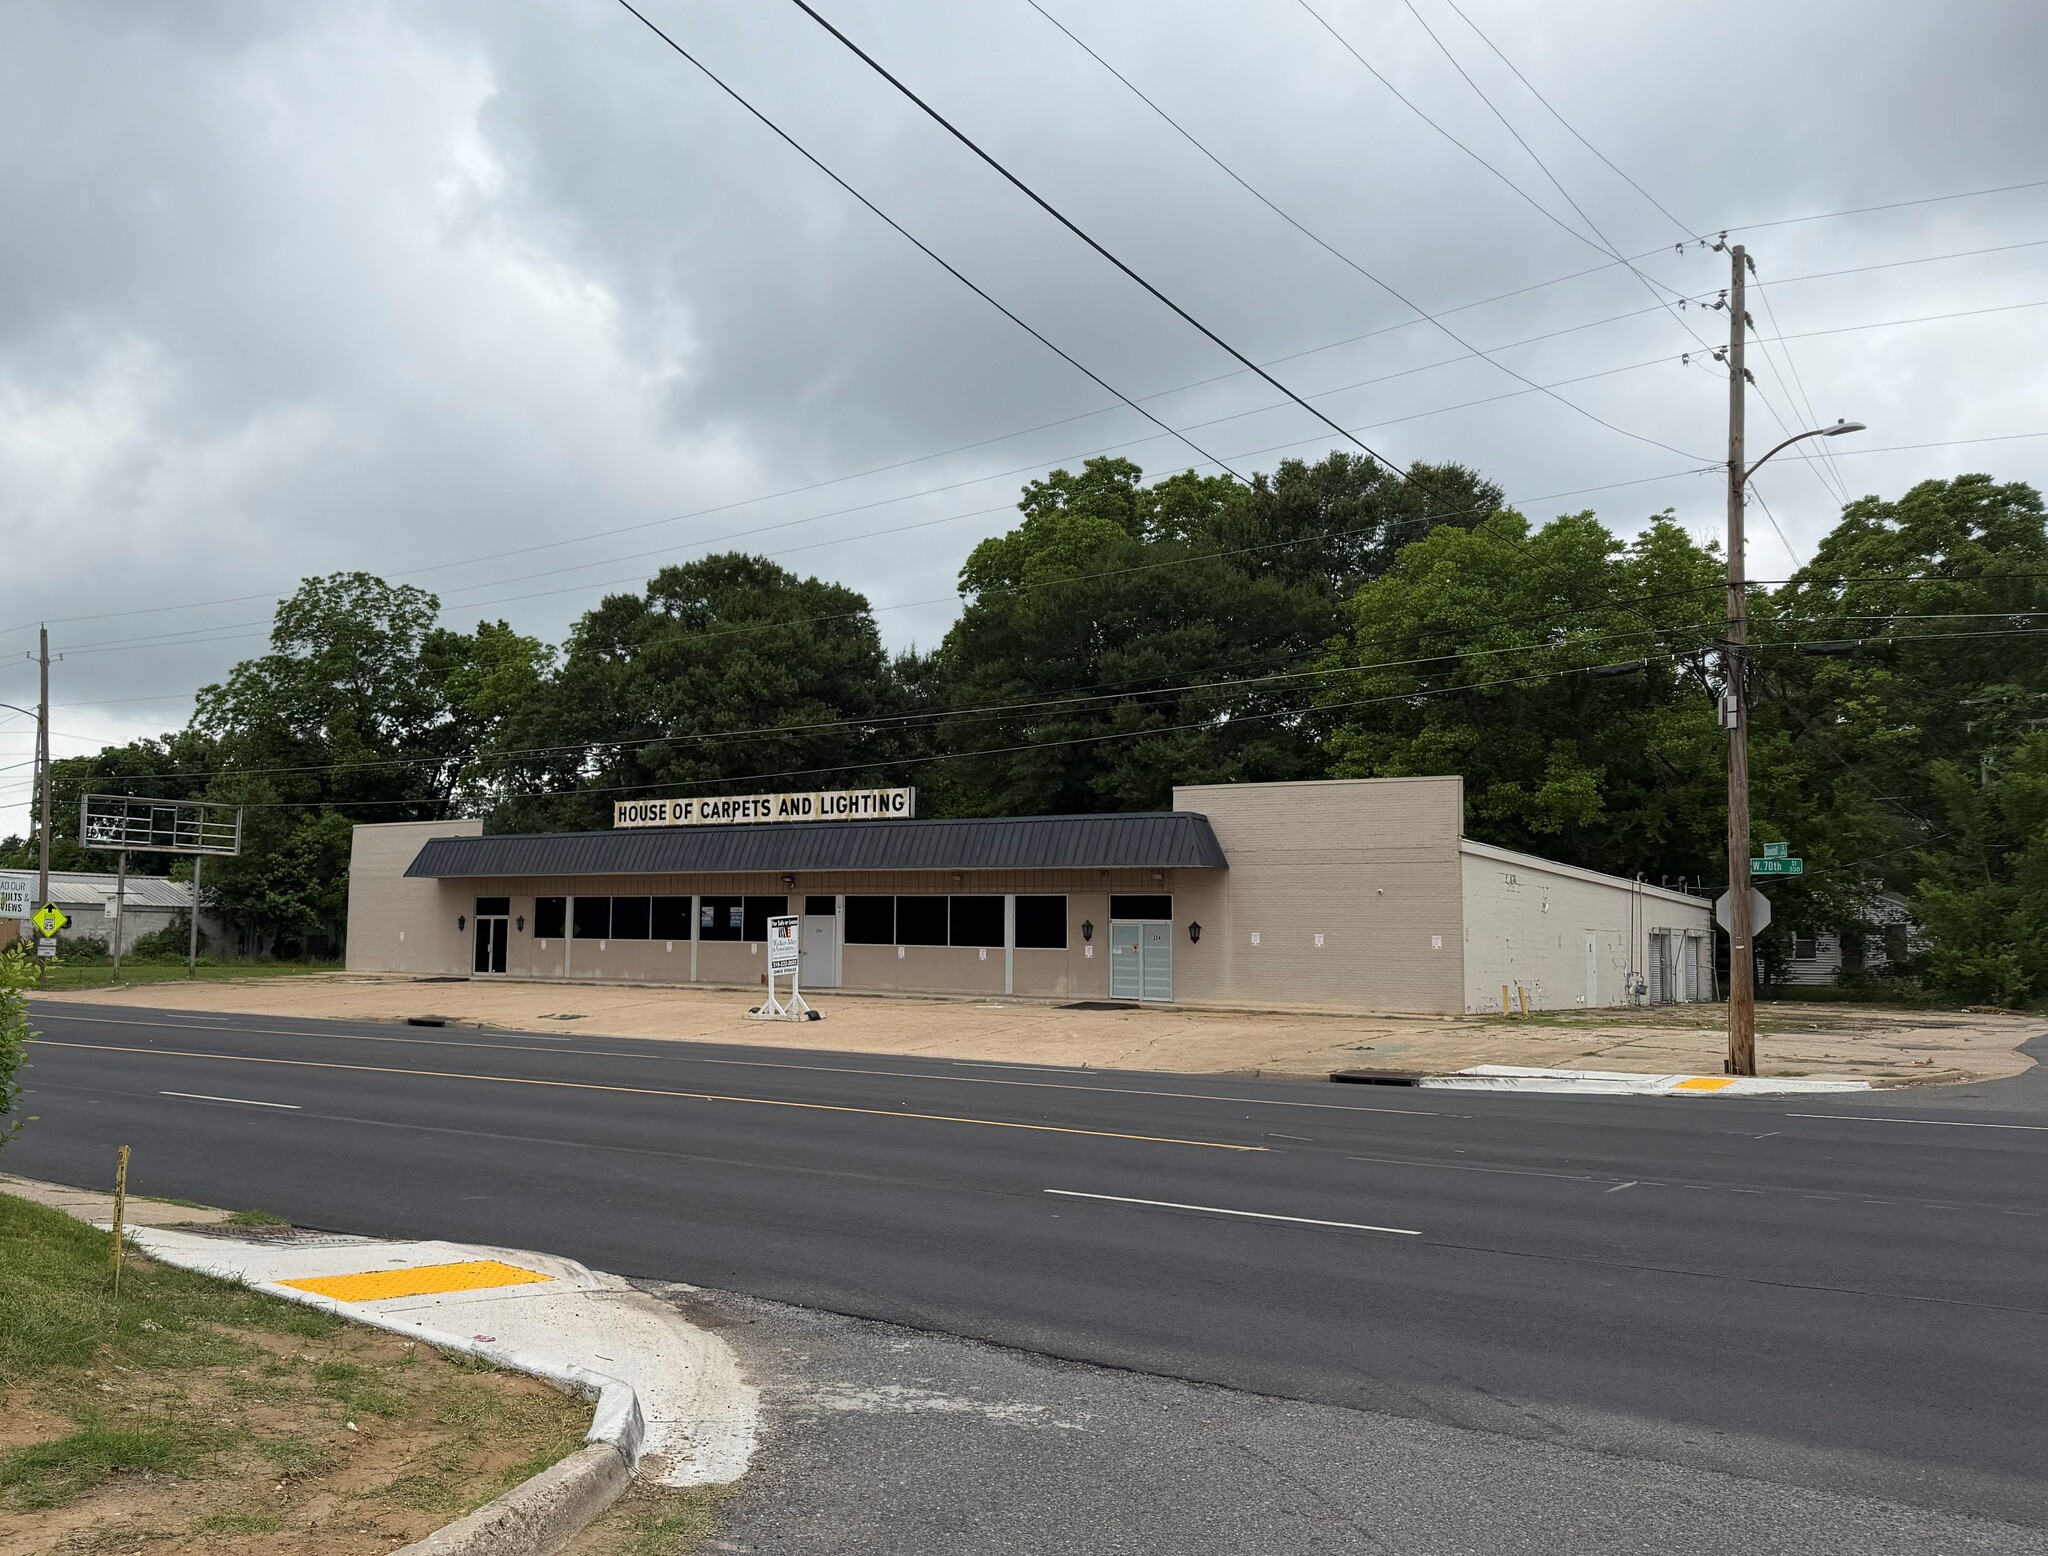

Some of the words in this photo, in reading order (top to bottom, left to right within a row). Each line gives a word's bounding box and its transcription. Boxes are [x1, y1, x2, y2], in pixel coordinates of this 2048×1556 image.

[618, 803, 667, 823] HOUSE
[673, 802, 693, 820] OF
[700, 799, 771, 820] CARPETS
[779, 797, 812, 816] AND
[820, 793, 905, 815] LIGHTING
[1764, 861, 1782, 871] 70th
[11, 881, 26, 891] OUR
[25, 893, 30, 902] &
